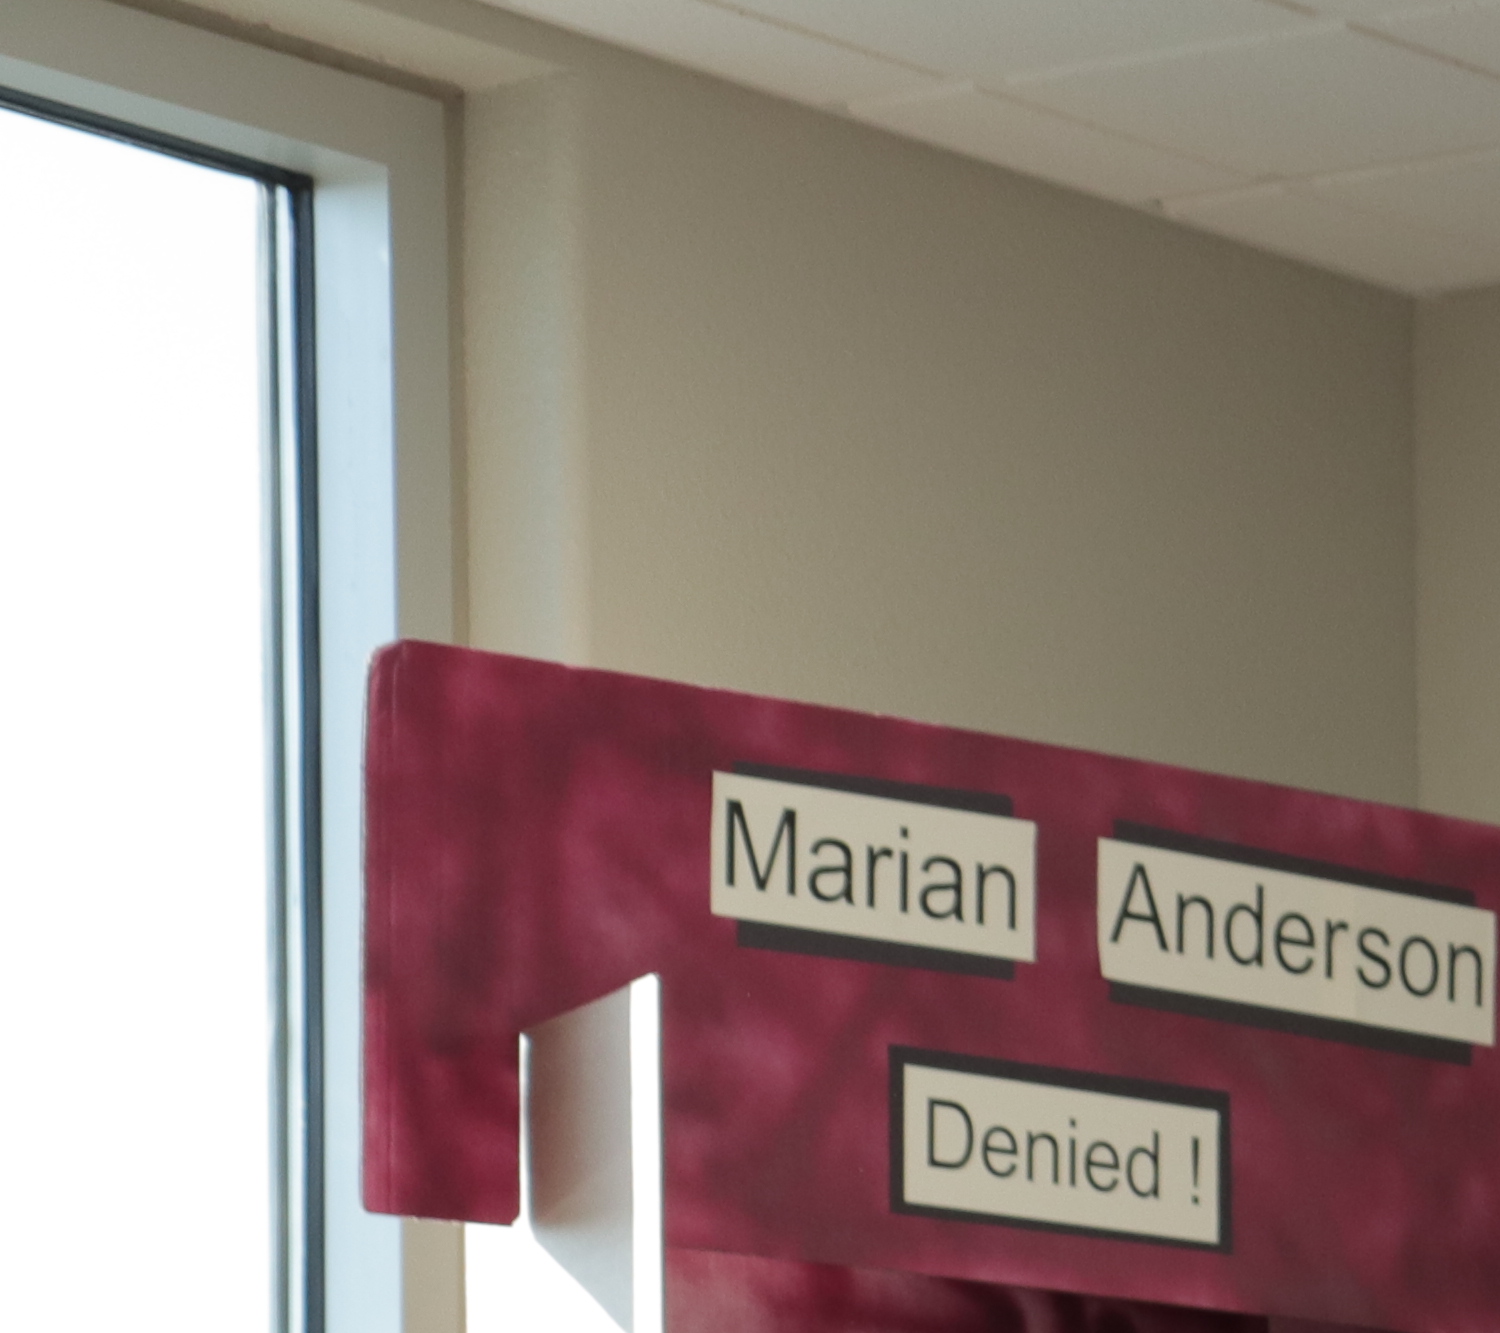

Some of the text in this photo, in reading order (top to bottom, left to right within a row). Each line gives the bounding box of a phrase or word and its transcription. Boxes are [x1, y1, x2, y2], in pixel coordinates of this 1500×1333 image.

[724, 799, 1485, 1008] Marian Anderson
[926, 1098, 1161, 1200] Denied
